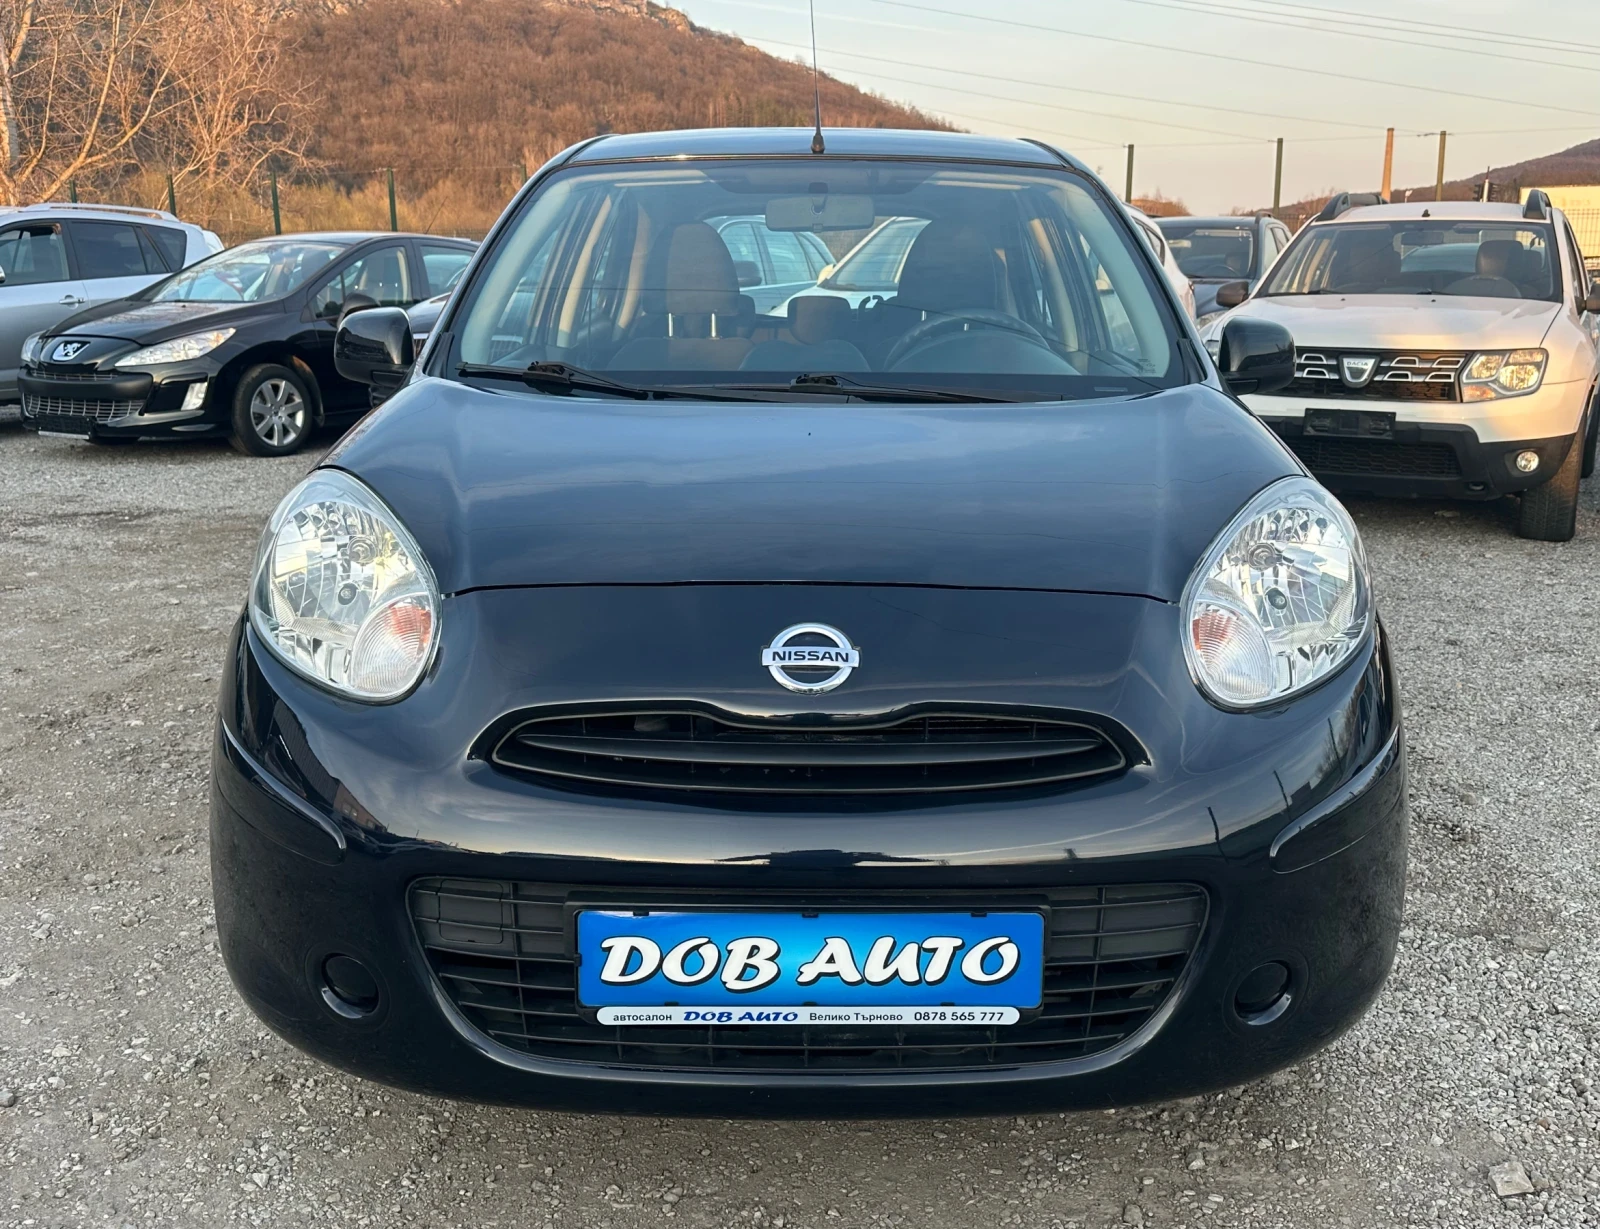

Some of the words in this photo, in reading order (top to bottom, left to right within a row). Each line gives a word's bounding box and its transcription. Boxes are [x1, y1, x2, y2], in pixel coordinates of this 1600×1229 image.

[772, 650, 849, 662] NISSAN
[599, 935, 782, 994] DOB
[795, 935, 1022, 987] AUTO
[613, 1013, 673, 1022] автосалон
[683, 1011, 733, 1023] DOB
[737, 1011, 799, 1022] AUTO
[809, 1012, 851, 1021] Велико
[853, 1012, 903, 1023] Търново
[914, 1011, 947, 1022] 0878
[950, 1011, 976, 1021] 565
[980, 1011, 1004, 1021] 777
